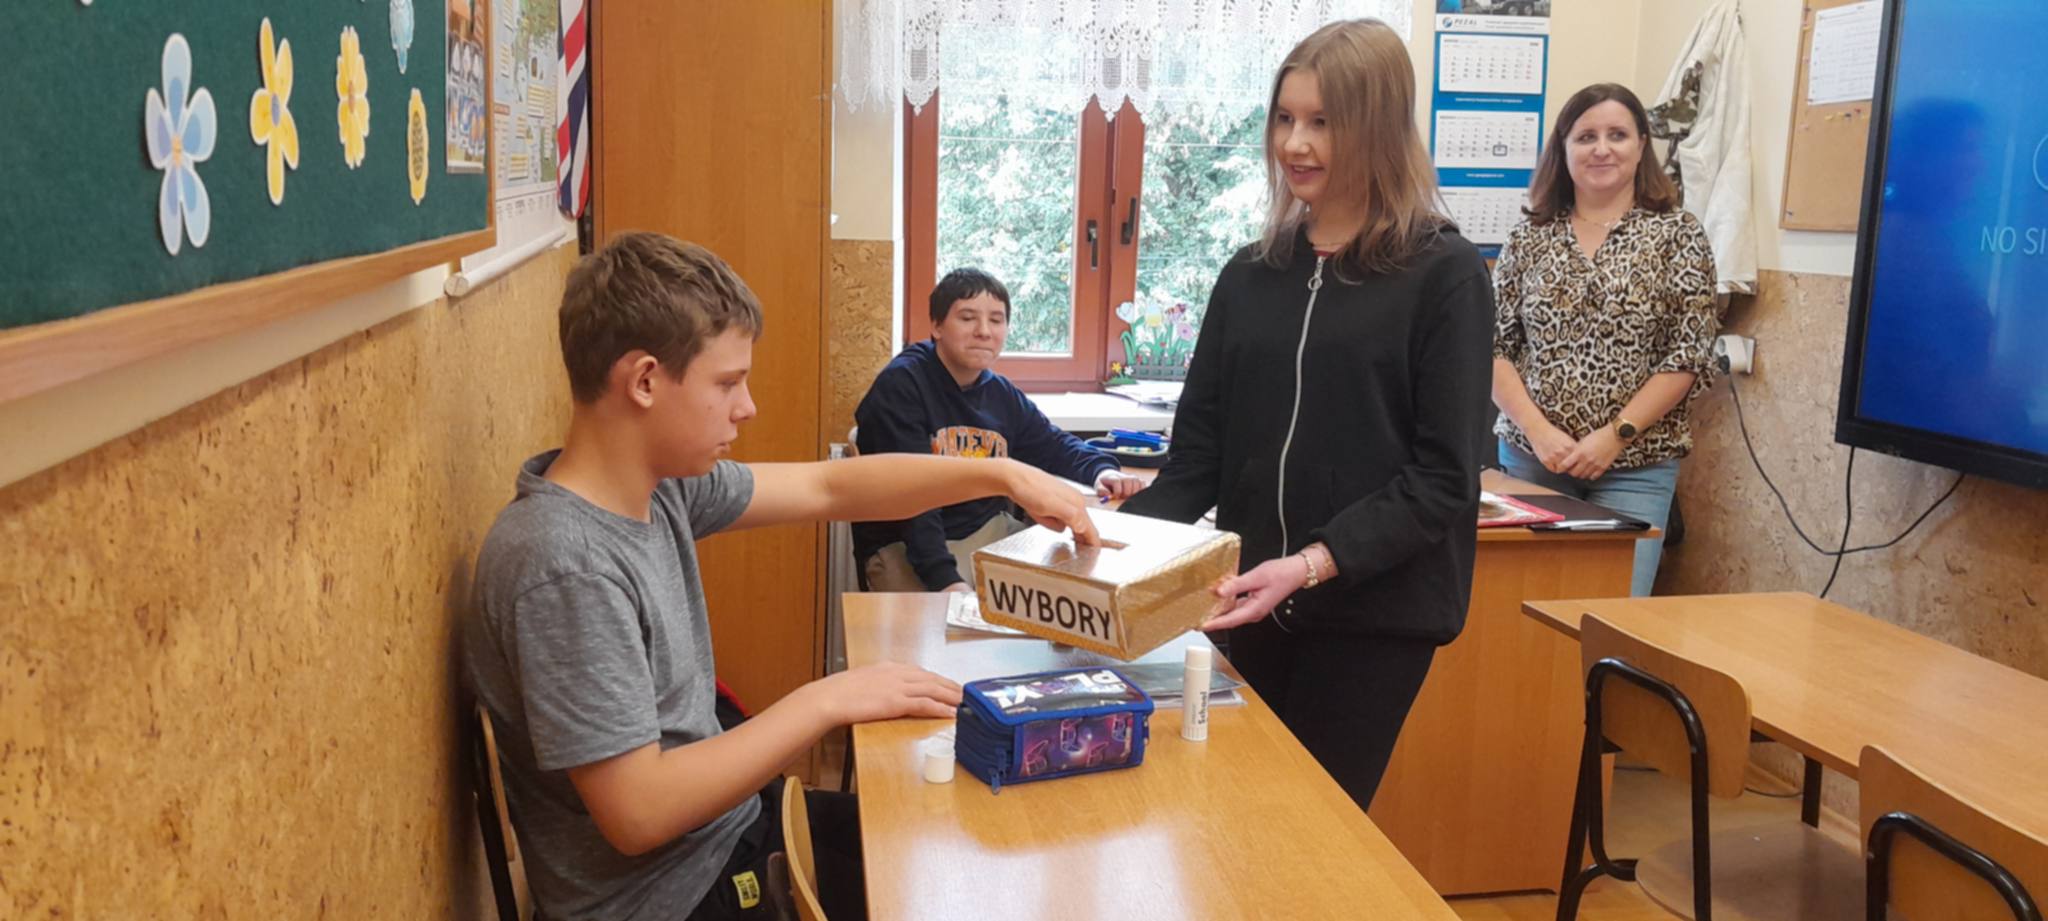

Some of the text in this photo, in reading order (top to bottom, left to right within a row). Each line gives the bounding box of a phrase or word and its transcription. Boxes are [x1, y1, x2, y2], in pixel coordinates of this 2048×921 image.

[1981, 225, 2046, 255] NO SI
[989, 578, 1110, 640] WYBORY
